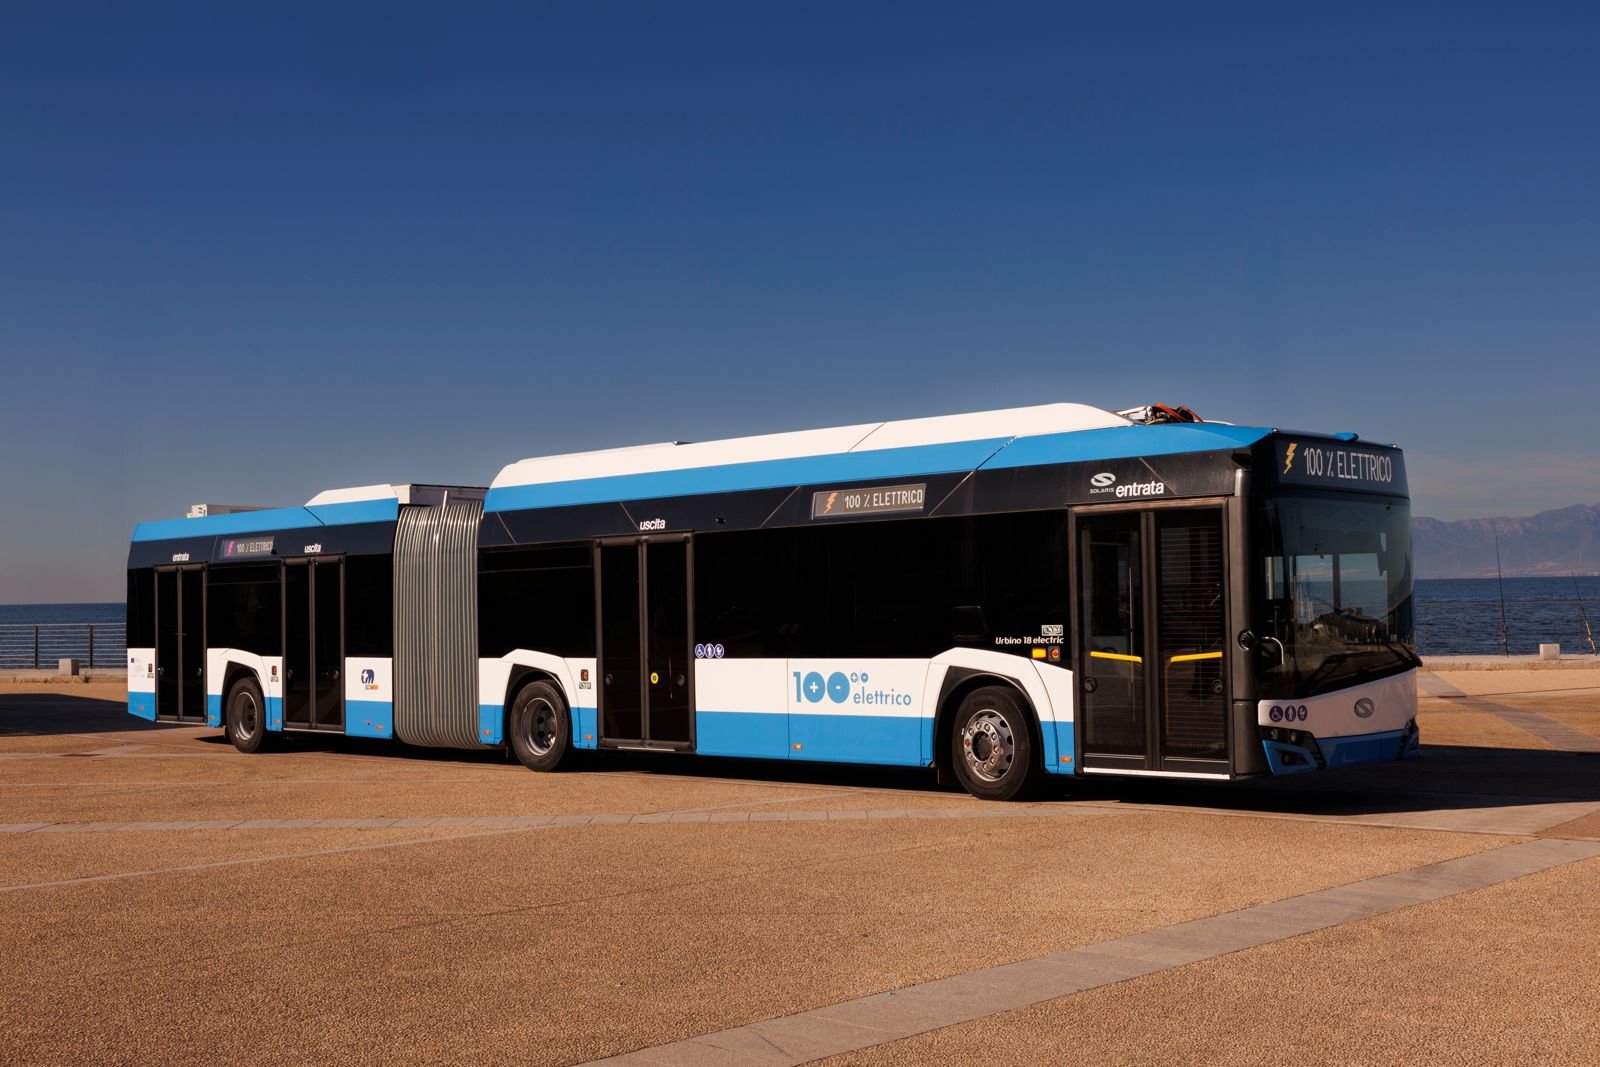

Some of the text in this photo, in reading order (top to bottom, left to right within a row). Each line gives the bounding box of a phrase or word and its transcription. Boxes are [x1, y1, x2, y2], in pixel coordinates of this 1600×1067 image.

[1303, 447, 1392, 482] 100 % ELETTRICO
[1115, 480, 1164, 497] entrata
[844, 489, 923, 509] 100 % ELETTRICO
[640, 518, 666, 531] uscita
[250, 541, 273, 552] ELETTRICO
[304, 543, 321, 553] uscita
[172, 552, 189, 561] entrata
[995, 635, 1064, 645] Urbino 18 electric
[853, 686, 912, 706] elettrico
